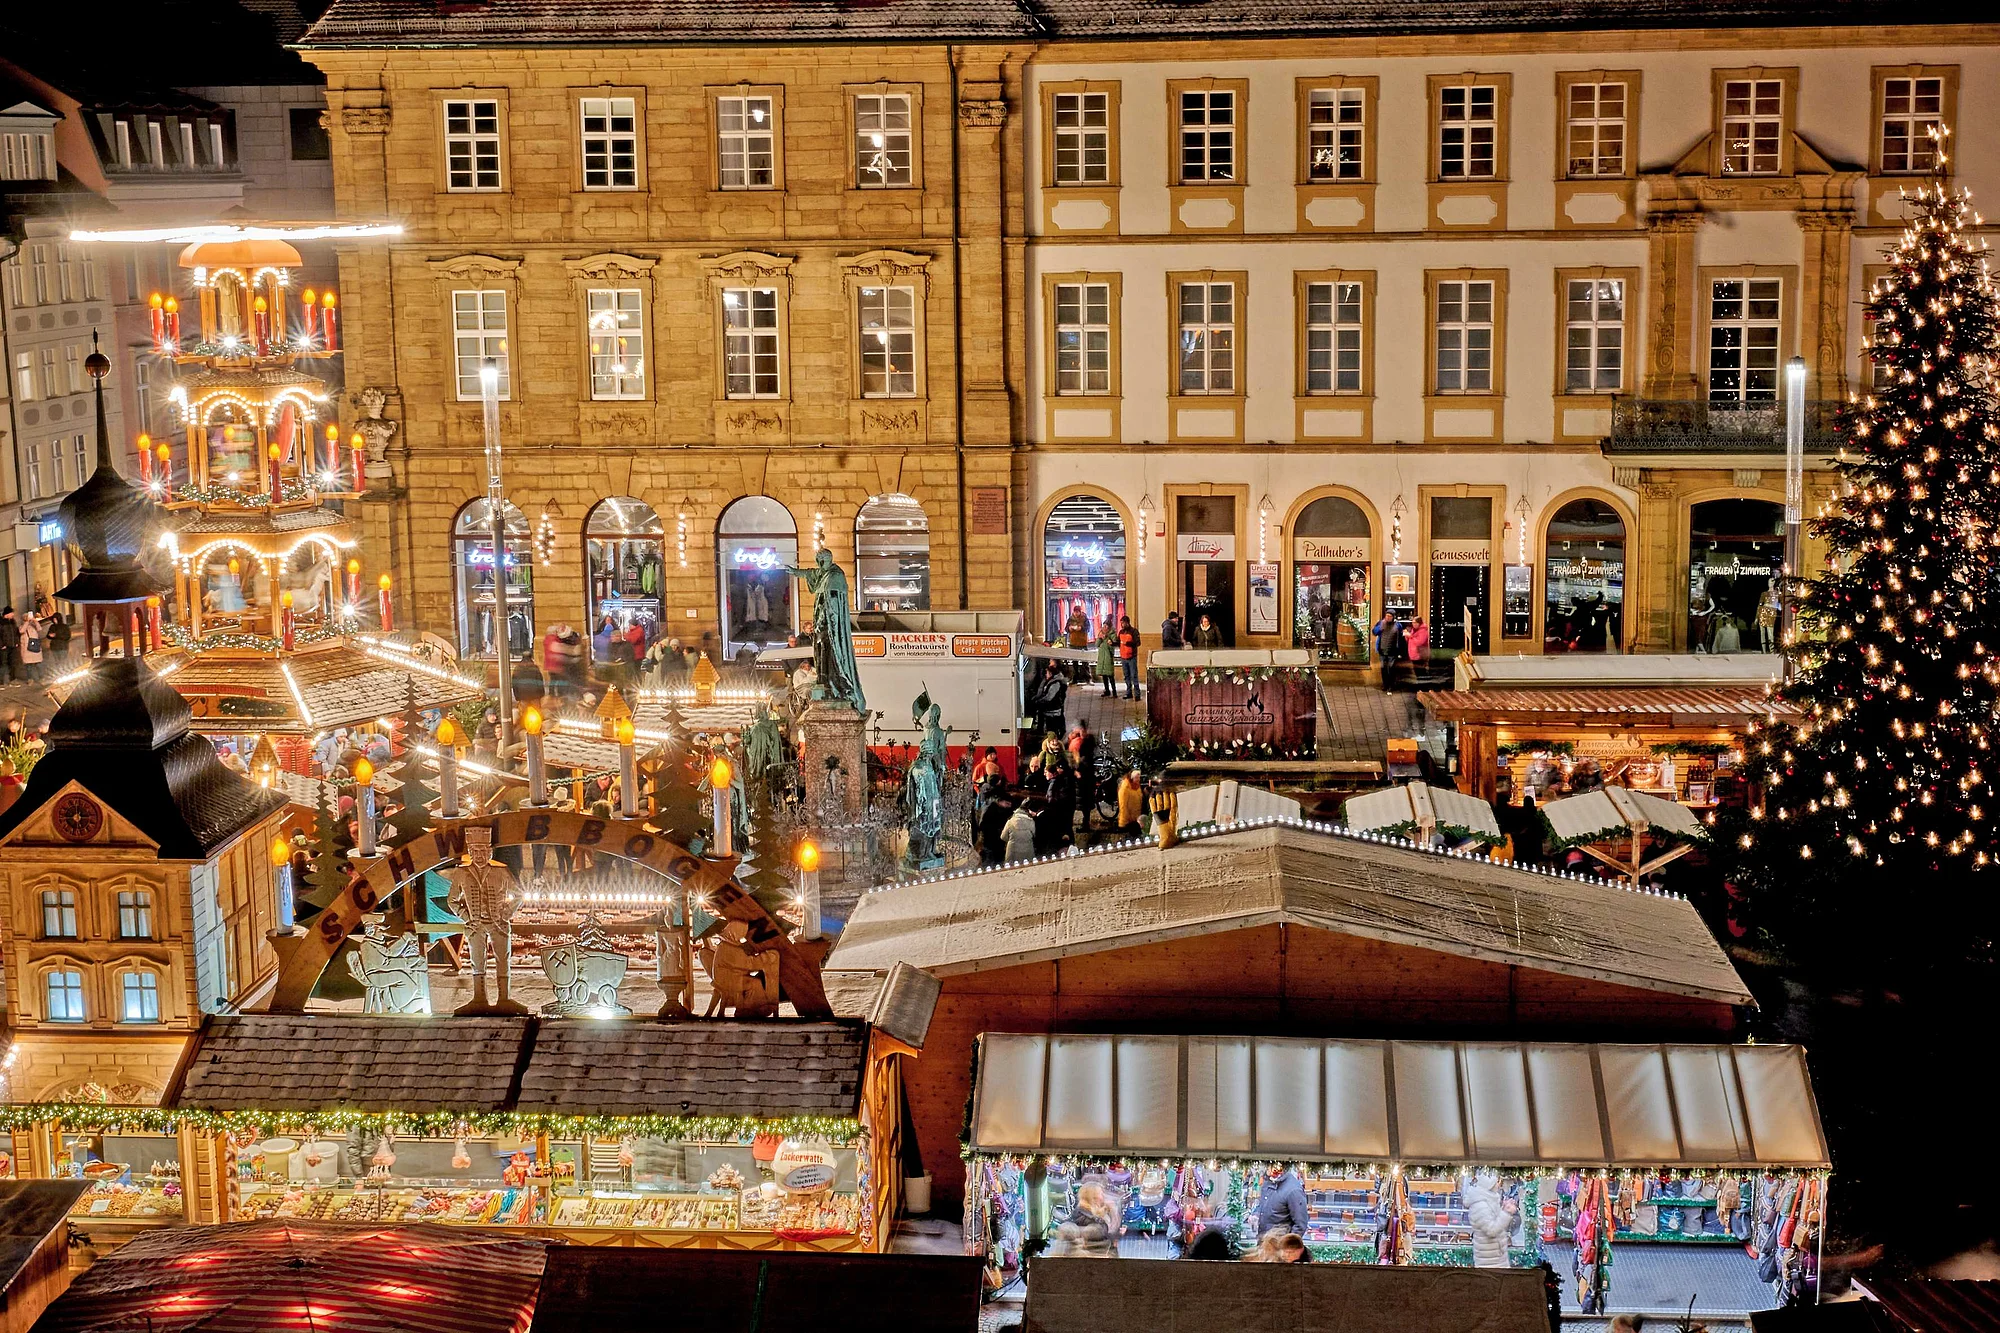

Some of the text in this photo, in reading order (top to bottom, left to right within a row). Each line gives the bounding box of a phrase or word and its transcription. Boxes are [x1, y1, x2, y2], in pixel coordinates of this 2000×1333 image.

[1188, 537, 1211, 552] Hinz
[1303, 540, 1363, 558] Pallhuber's
[733, 547, 780, 569] tredy
[1062, 541, 1107, 565] tredy
[1431, 548, 1490, 560] Genusswelt
[1553, 565, 1618, 575] FRAUEN ZIMMER
[1705, 565, 1771, 575] FRAUEN ZIMMER
[891, 634, 947, 642] HACKER'S
[956, 638, 1008, 646] Belegte Brötchen
[1188, 715, 1271, 723] FEUERZANGENBOWLE
[320, 813, 780, 945] SCHWIBBOGEN
